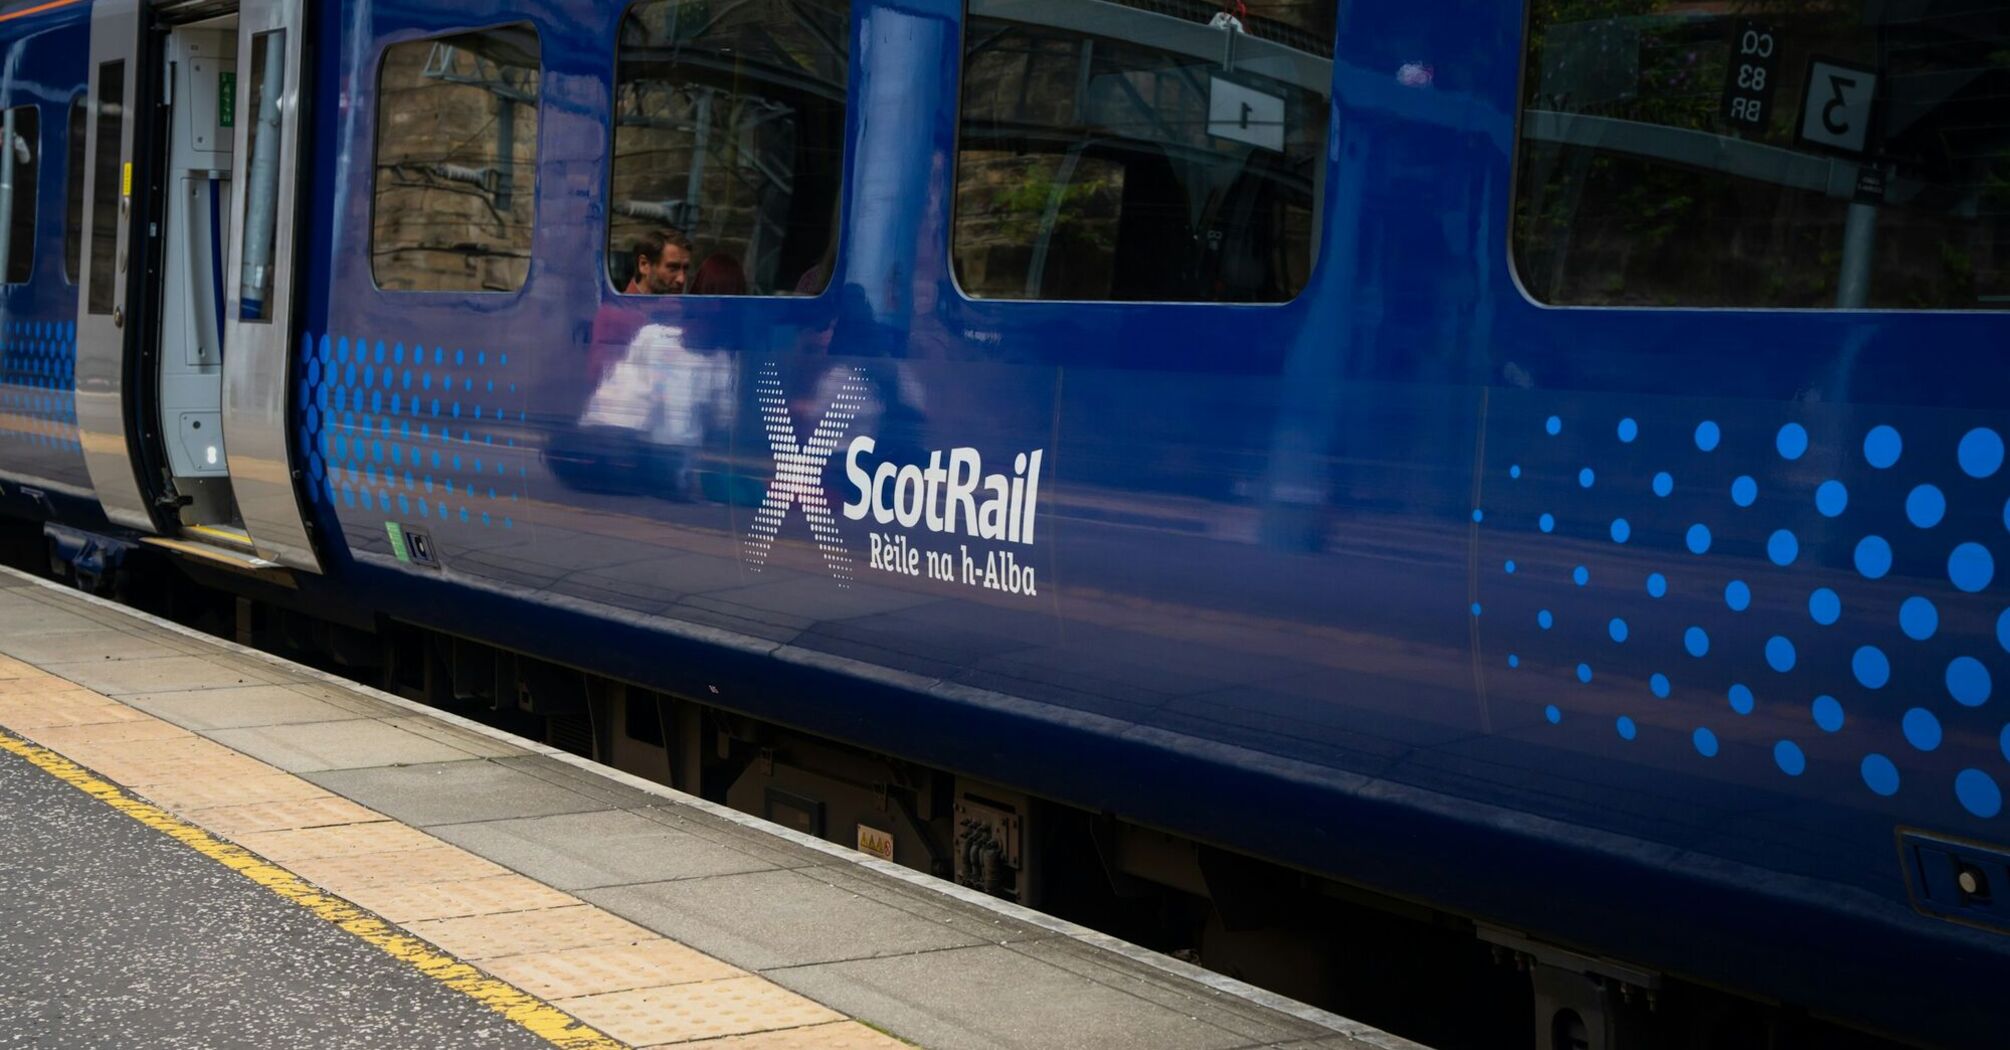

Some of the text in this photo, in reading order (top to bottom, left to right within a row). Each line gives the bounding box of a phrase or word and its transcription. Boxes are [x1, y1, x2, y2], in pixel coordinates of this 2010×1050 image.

[843, 435, 1043, 545] ScotRail
[869, 532, 1037, 596] Rèile na h-Alba
